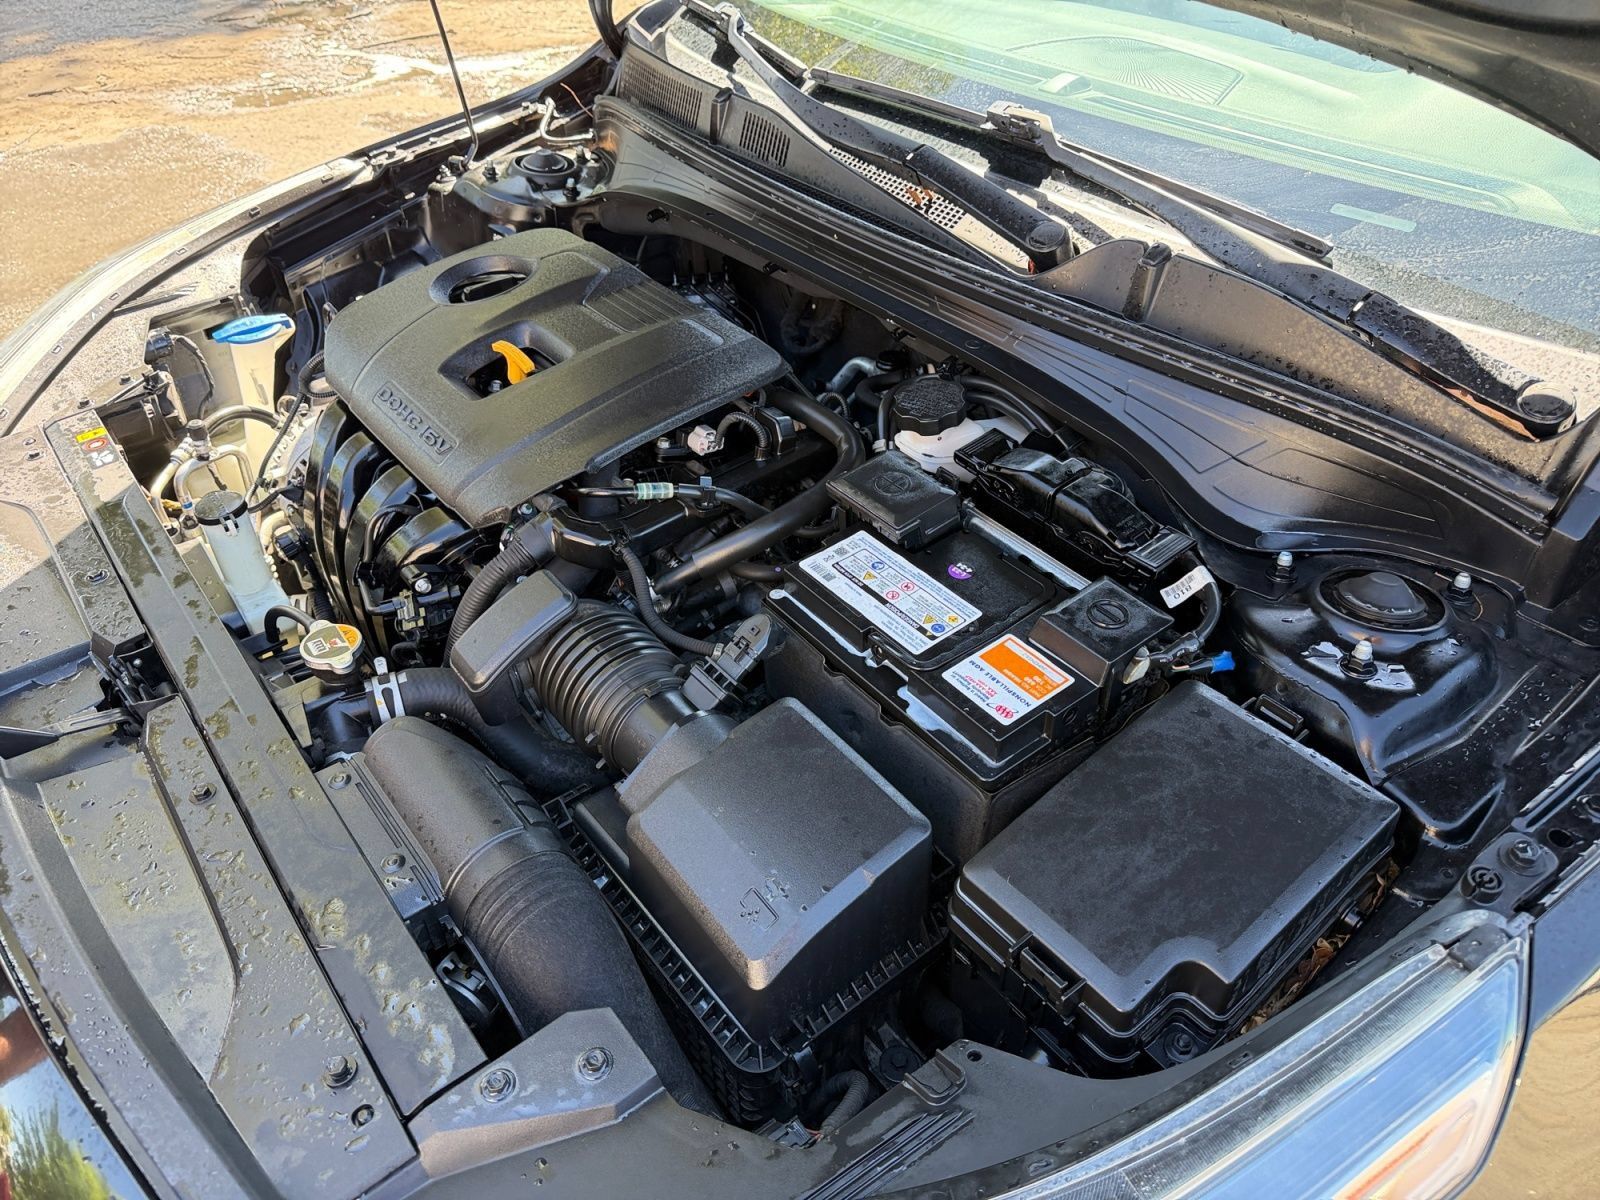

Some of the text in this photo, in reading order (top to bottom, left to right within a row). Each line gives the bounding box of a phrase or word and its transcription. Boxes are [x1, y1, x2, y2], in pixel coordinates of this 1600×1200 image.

[377, 386, 423, 431] DOHC
[967, 659, 985, 672] AGM
[984, 671, 1032, 707] NONSPILLABLE
